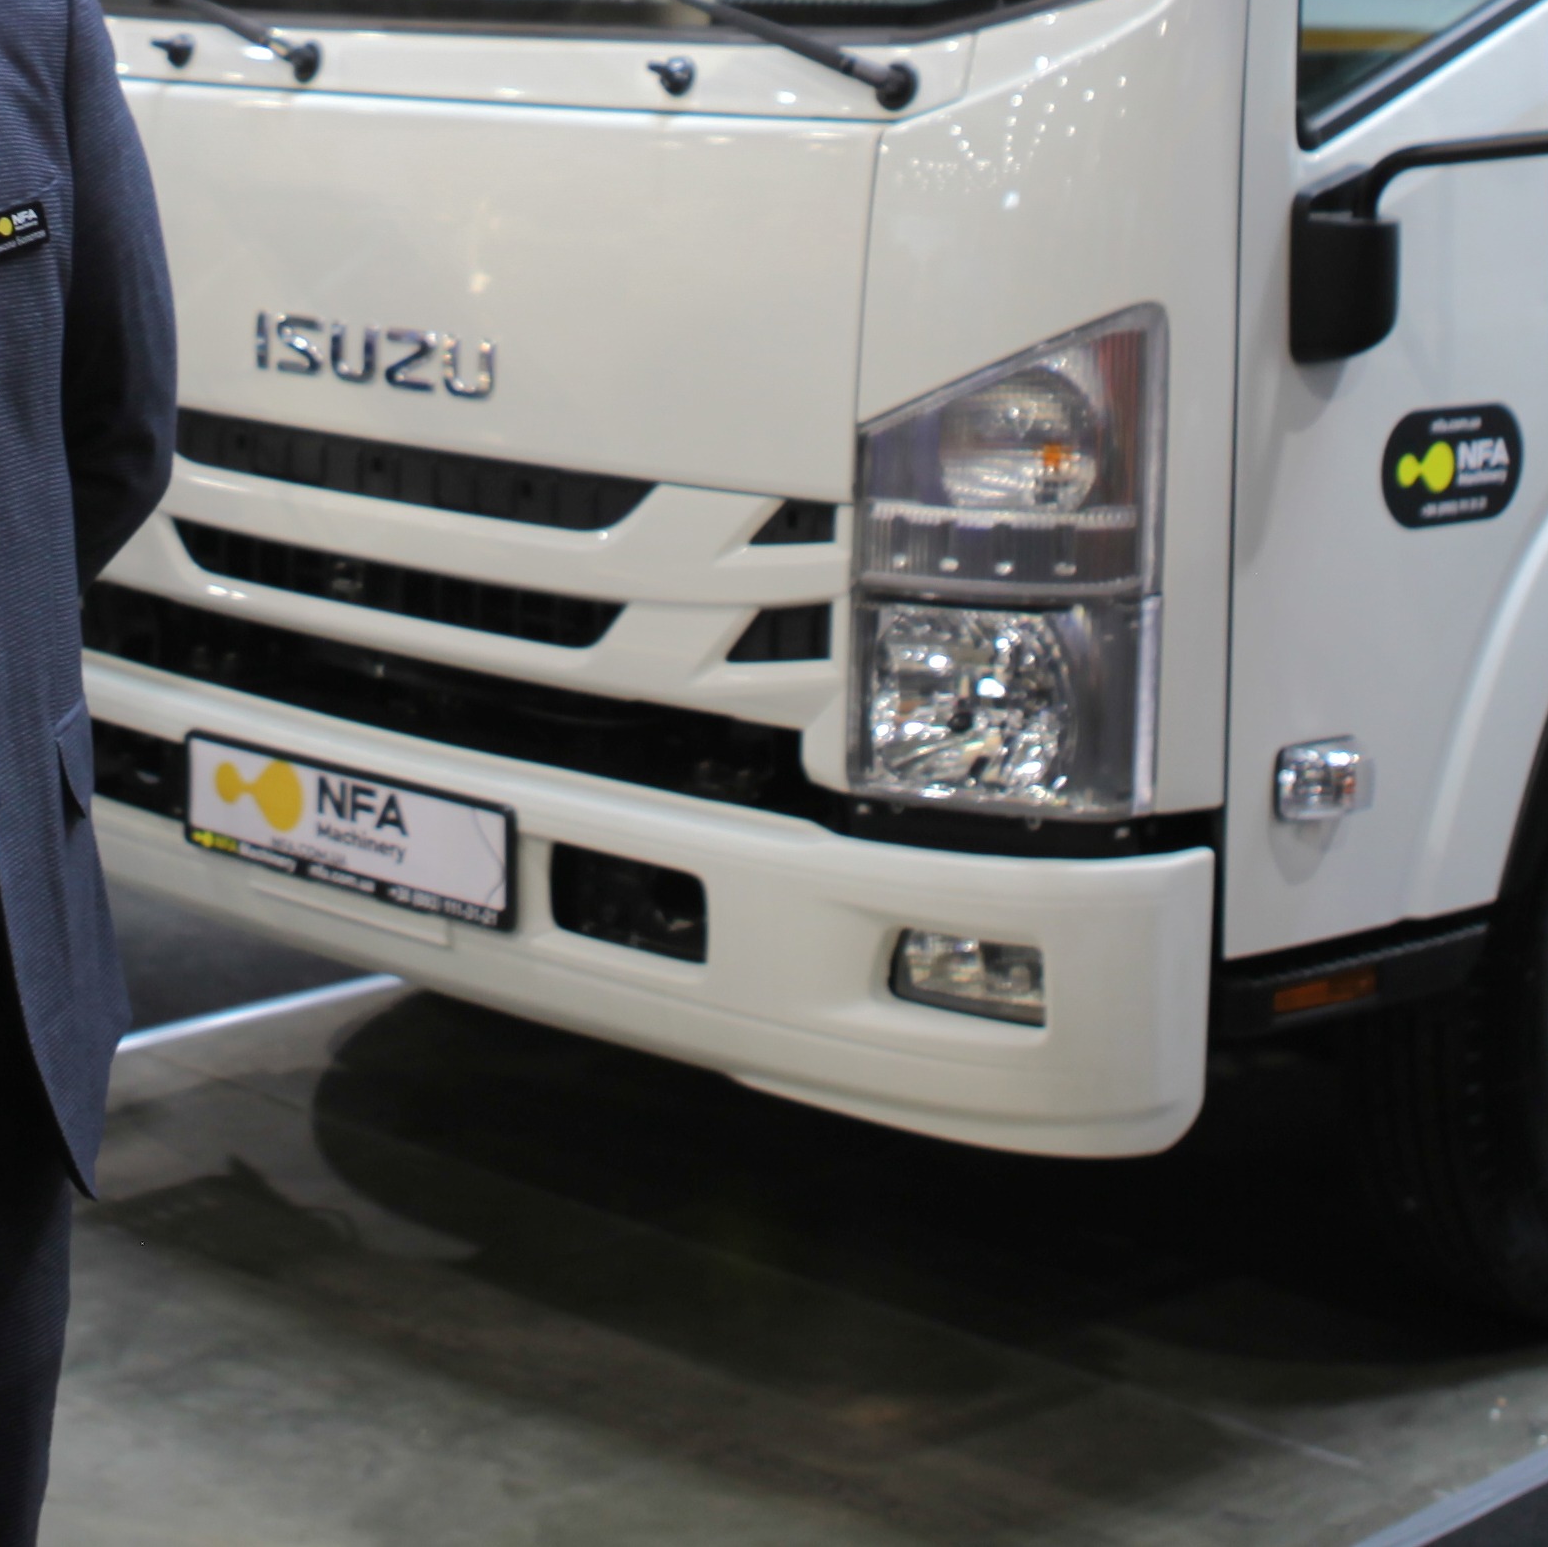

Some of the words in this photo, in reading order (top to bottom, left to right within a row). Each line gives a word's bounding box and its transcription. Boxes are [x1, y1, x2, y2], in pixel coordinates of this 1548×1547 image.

[255, 310, 498, 400] ISUZU
[1456, 437, 1510, 470] NFA
[317, 775, 408, 837] NFA
[316, 821, 407, 865] Machinery
